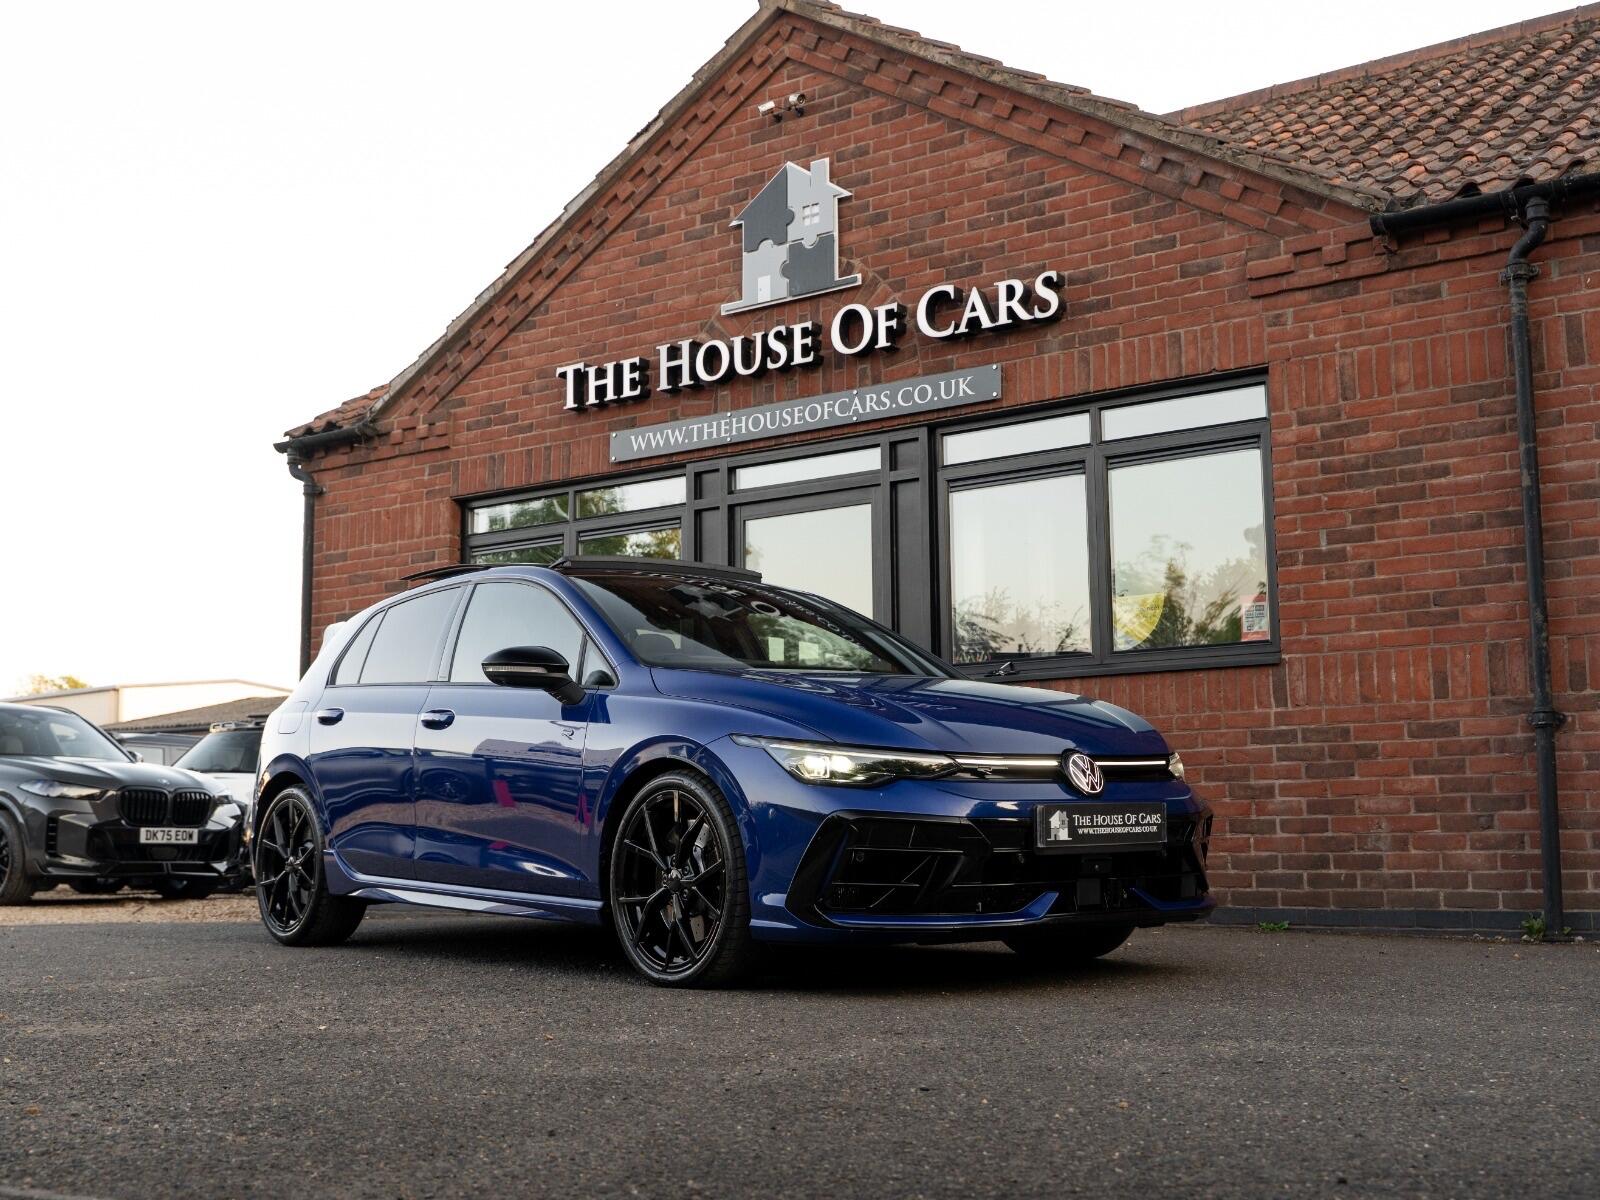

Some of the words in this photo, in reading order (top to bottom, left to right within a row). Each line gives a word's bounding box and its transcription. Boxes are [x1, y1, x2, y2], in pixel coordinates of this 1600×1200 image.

[556, 361, 641, 411] THE
[656, 321, 816, 393] HOUSE
[830, 302, 899, 356] OF
[916, 270, 1060, 340] CARS
[630, 375, 976, 453] WWW.THEHOUSEOFCARS.CO.UK
[145, 829, 173, 841] DK75
[175, 830, 194, 841] EOW
[1073, 814, 1092, 826] THE
[1093, 814, 1124, 826] HOUSE
[1125, 813, 1138, 825] OF
[1139, 812, 1162, 824] CARS
